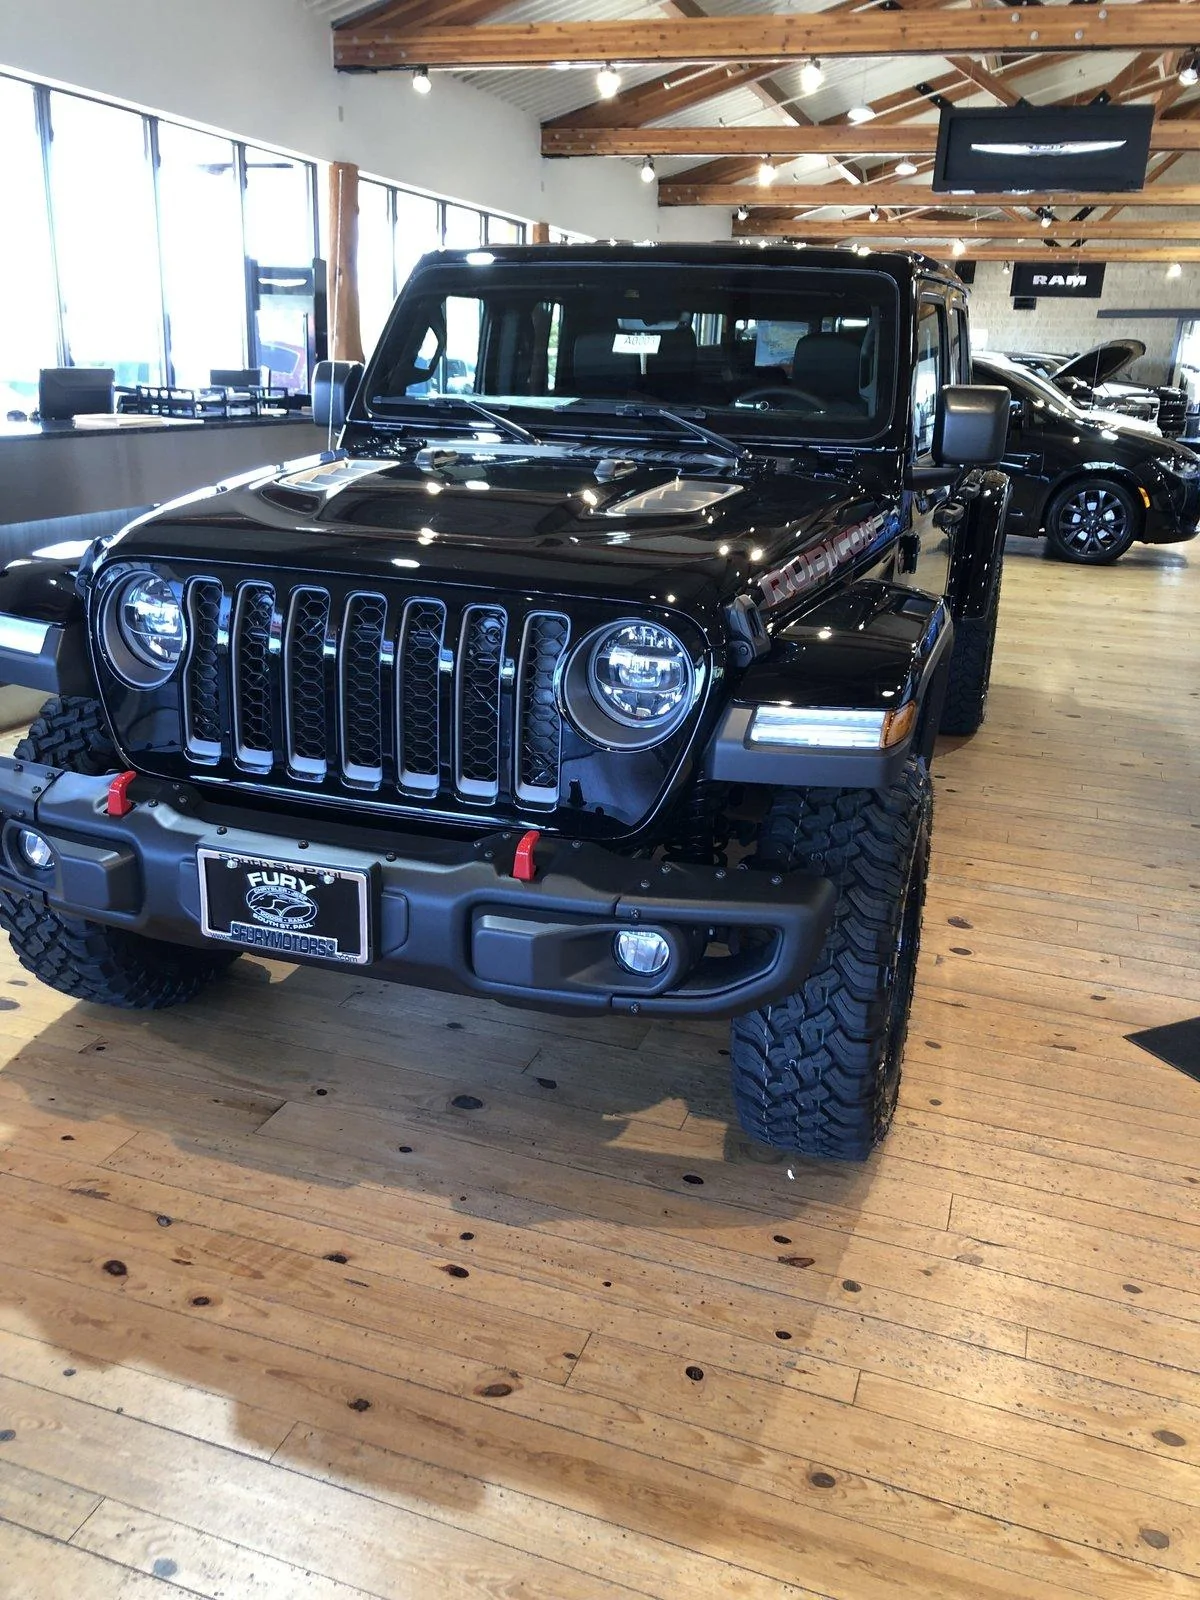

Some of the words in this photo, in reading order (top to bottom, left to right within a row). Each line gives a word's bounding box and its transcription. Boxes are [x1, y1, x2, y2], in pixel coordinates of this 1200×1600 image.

[1033, 274, 1087, 287] RAM
[760, 515, 880, 607] RUBICON
[247, 871, 316, 895] FURY
[252, 913, 279, 927] SOUTH
[293, 922, 314, 930] PAUL
